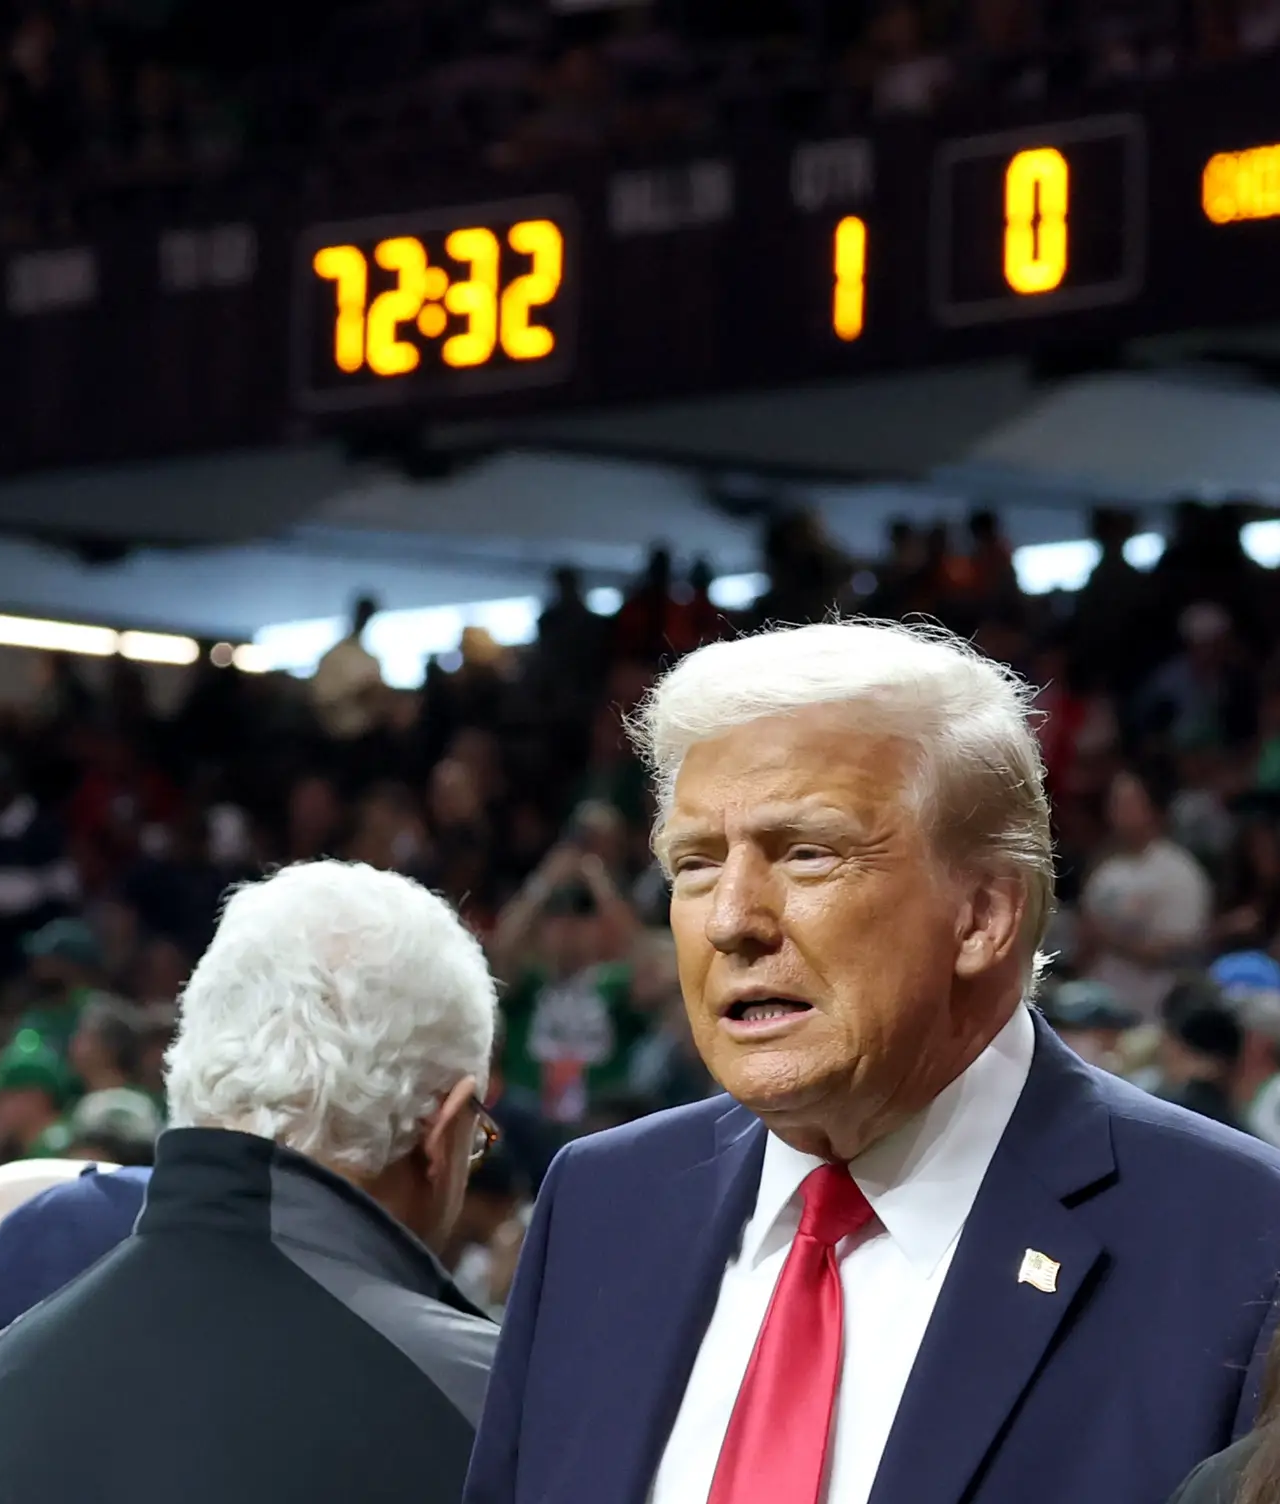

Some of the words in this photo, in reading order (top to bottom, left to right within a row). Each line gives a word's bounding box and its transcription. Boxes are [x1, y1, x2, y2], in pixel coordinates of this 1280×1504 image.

[832, 215, 868, 341] 1
[1002, 146, 1070, 295] 0
[313, 218, 565, 377] 72:32
